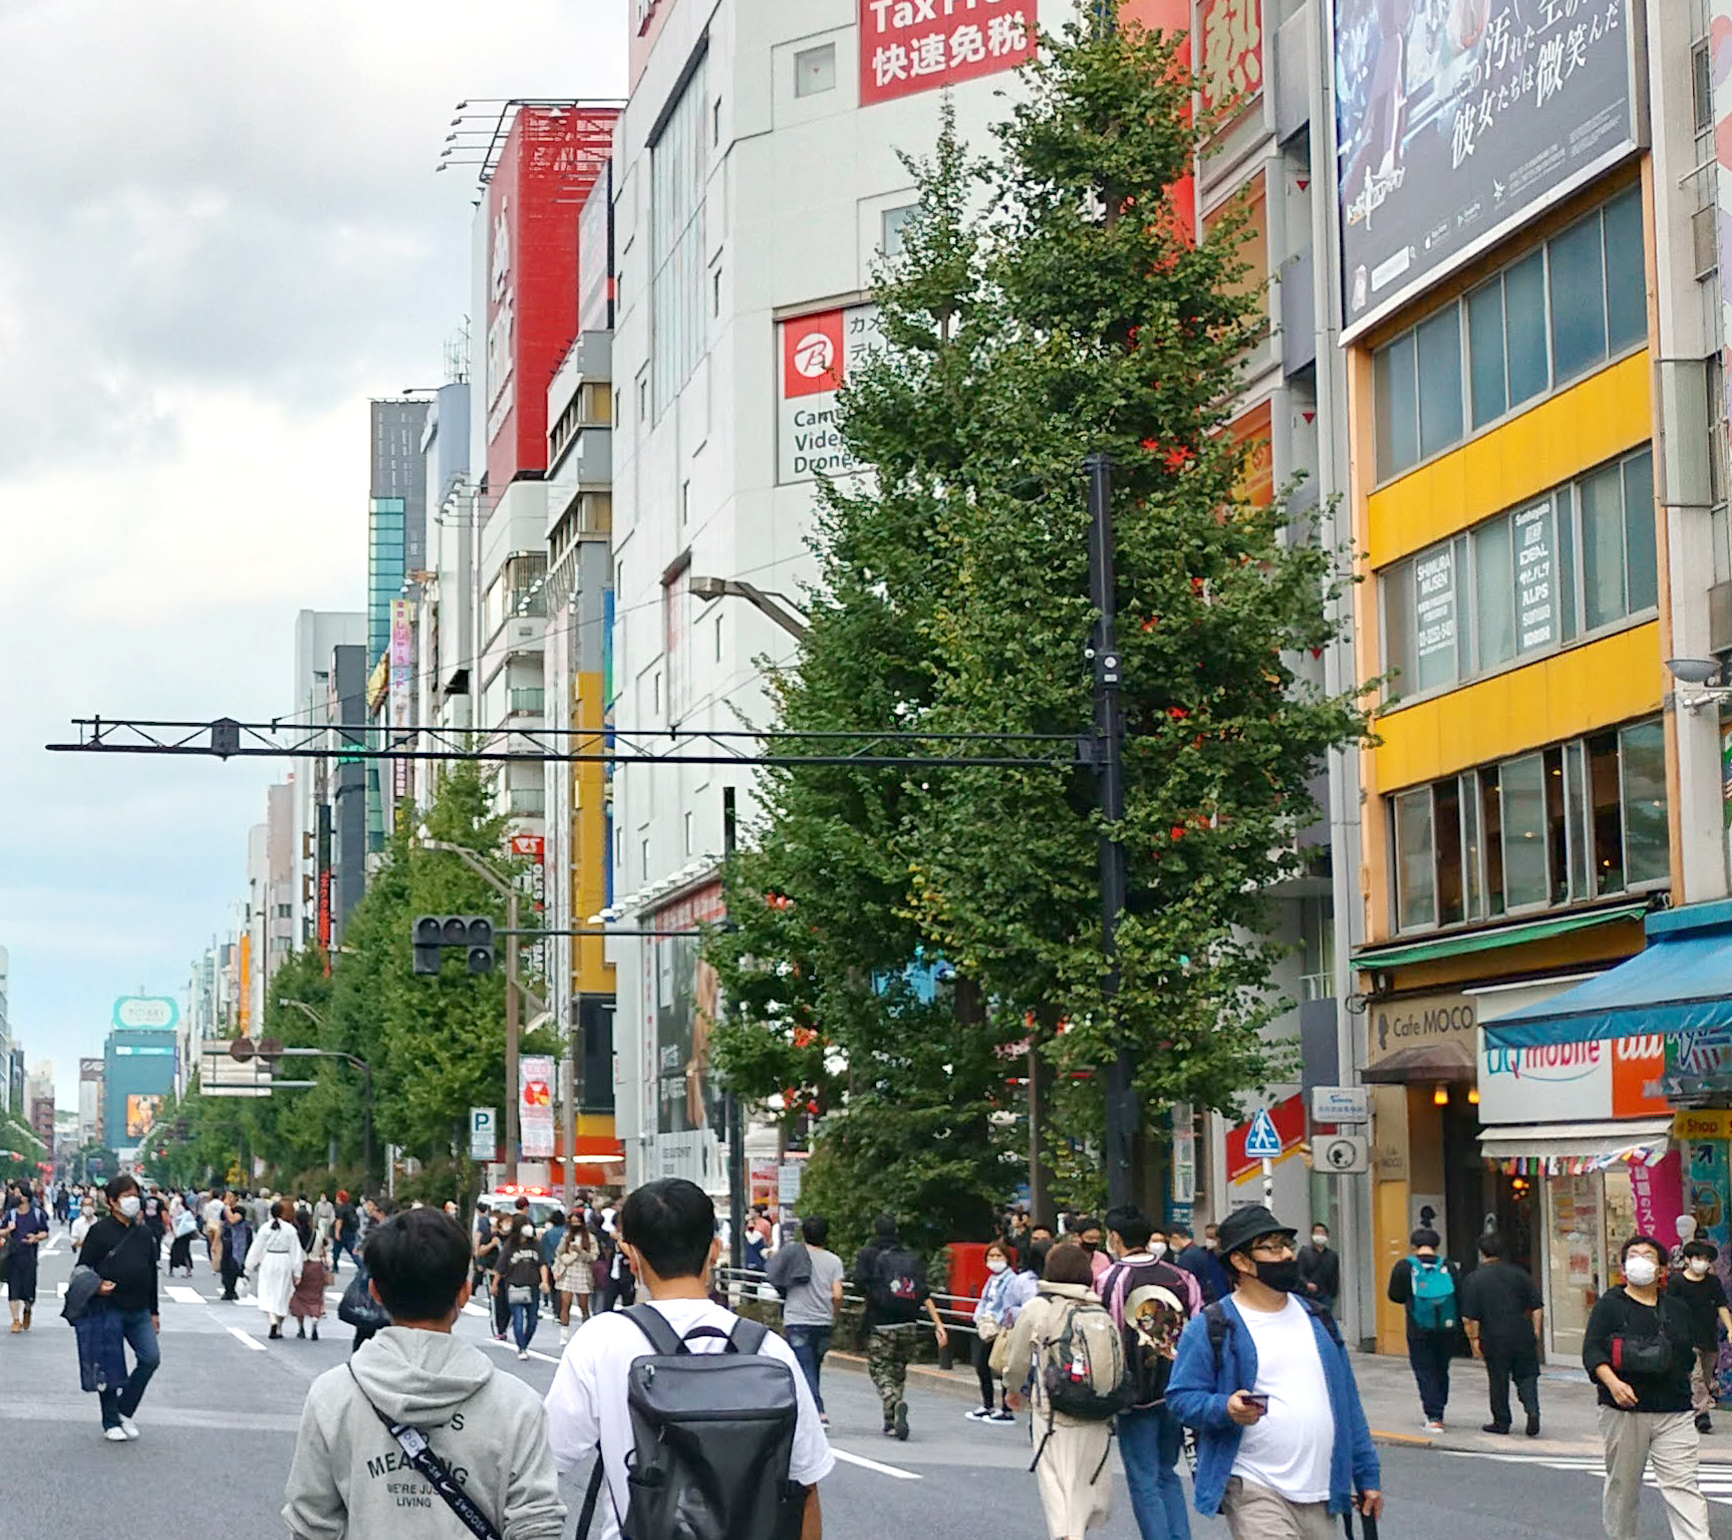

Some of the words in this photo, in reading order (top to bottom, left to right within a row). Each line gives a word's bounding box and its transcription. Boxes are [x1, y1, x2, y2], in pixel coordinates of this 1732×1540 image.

[871, 10, 1028, 87] 快速免税
[794, 429, 845, 452] Vide
[1522, 582, 1549, 607] ALPS
[1393, 1017, 1421, 1038] Cafe
[1423, 1005, 1474, 1035] MOCO
[475, 1112, 490, 1132] P
[1687, 1119, 1718, 1135] Shop
[419, 1483, 439, 1495] JUS
[396, 1495, 432, 1508] LIVING
